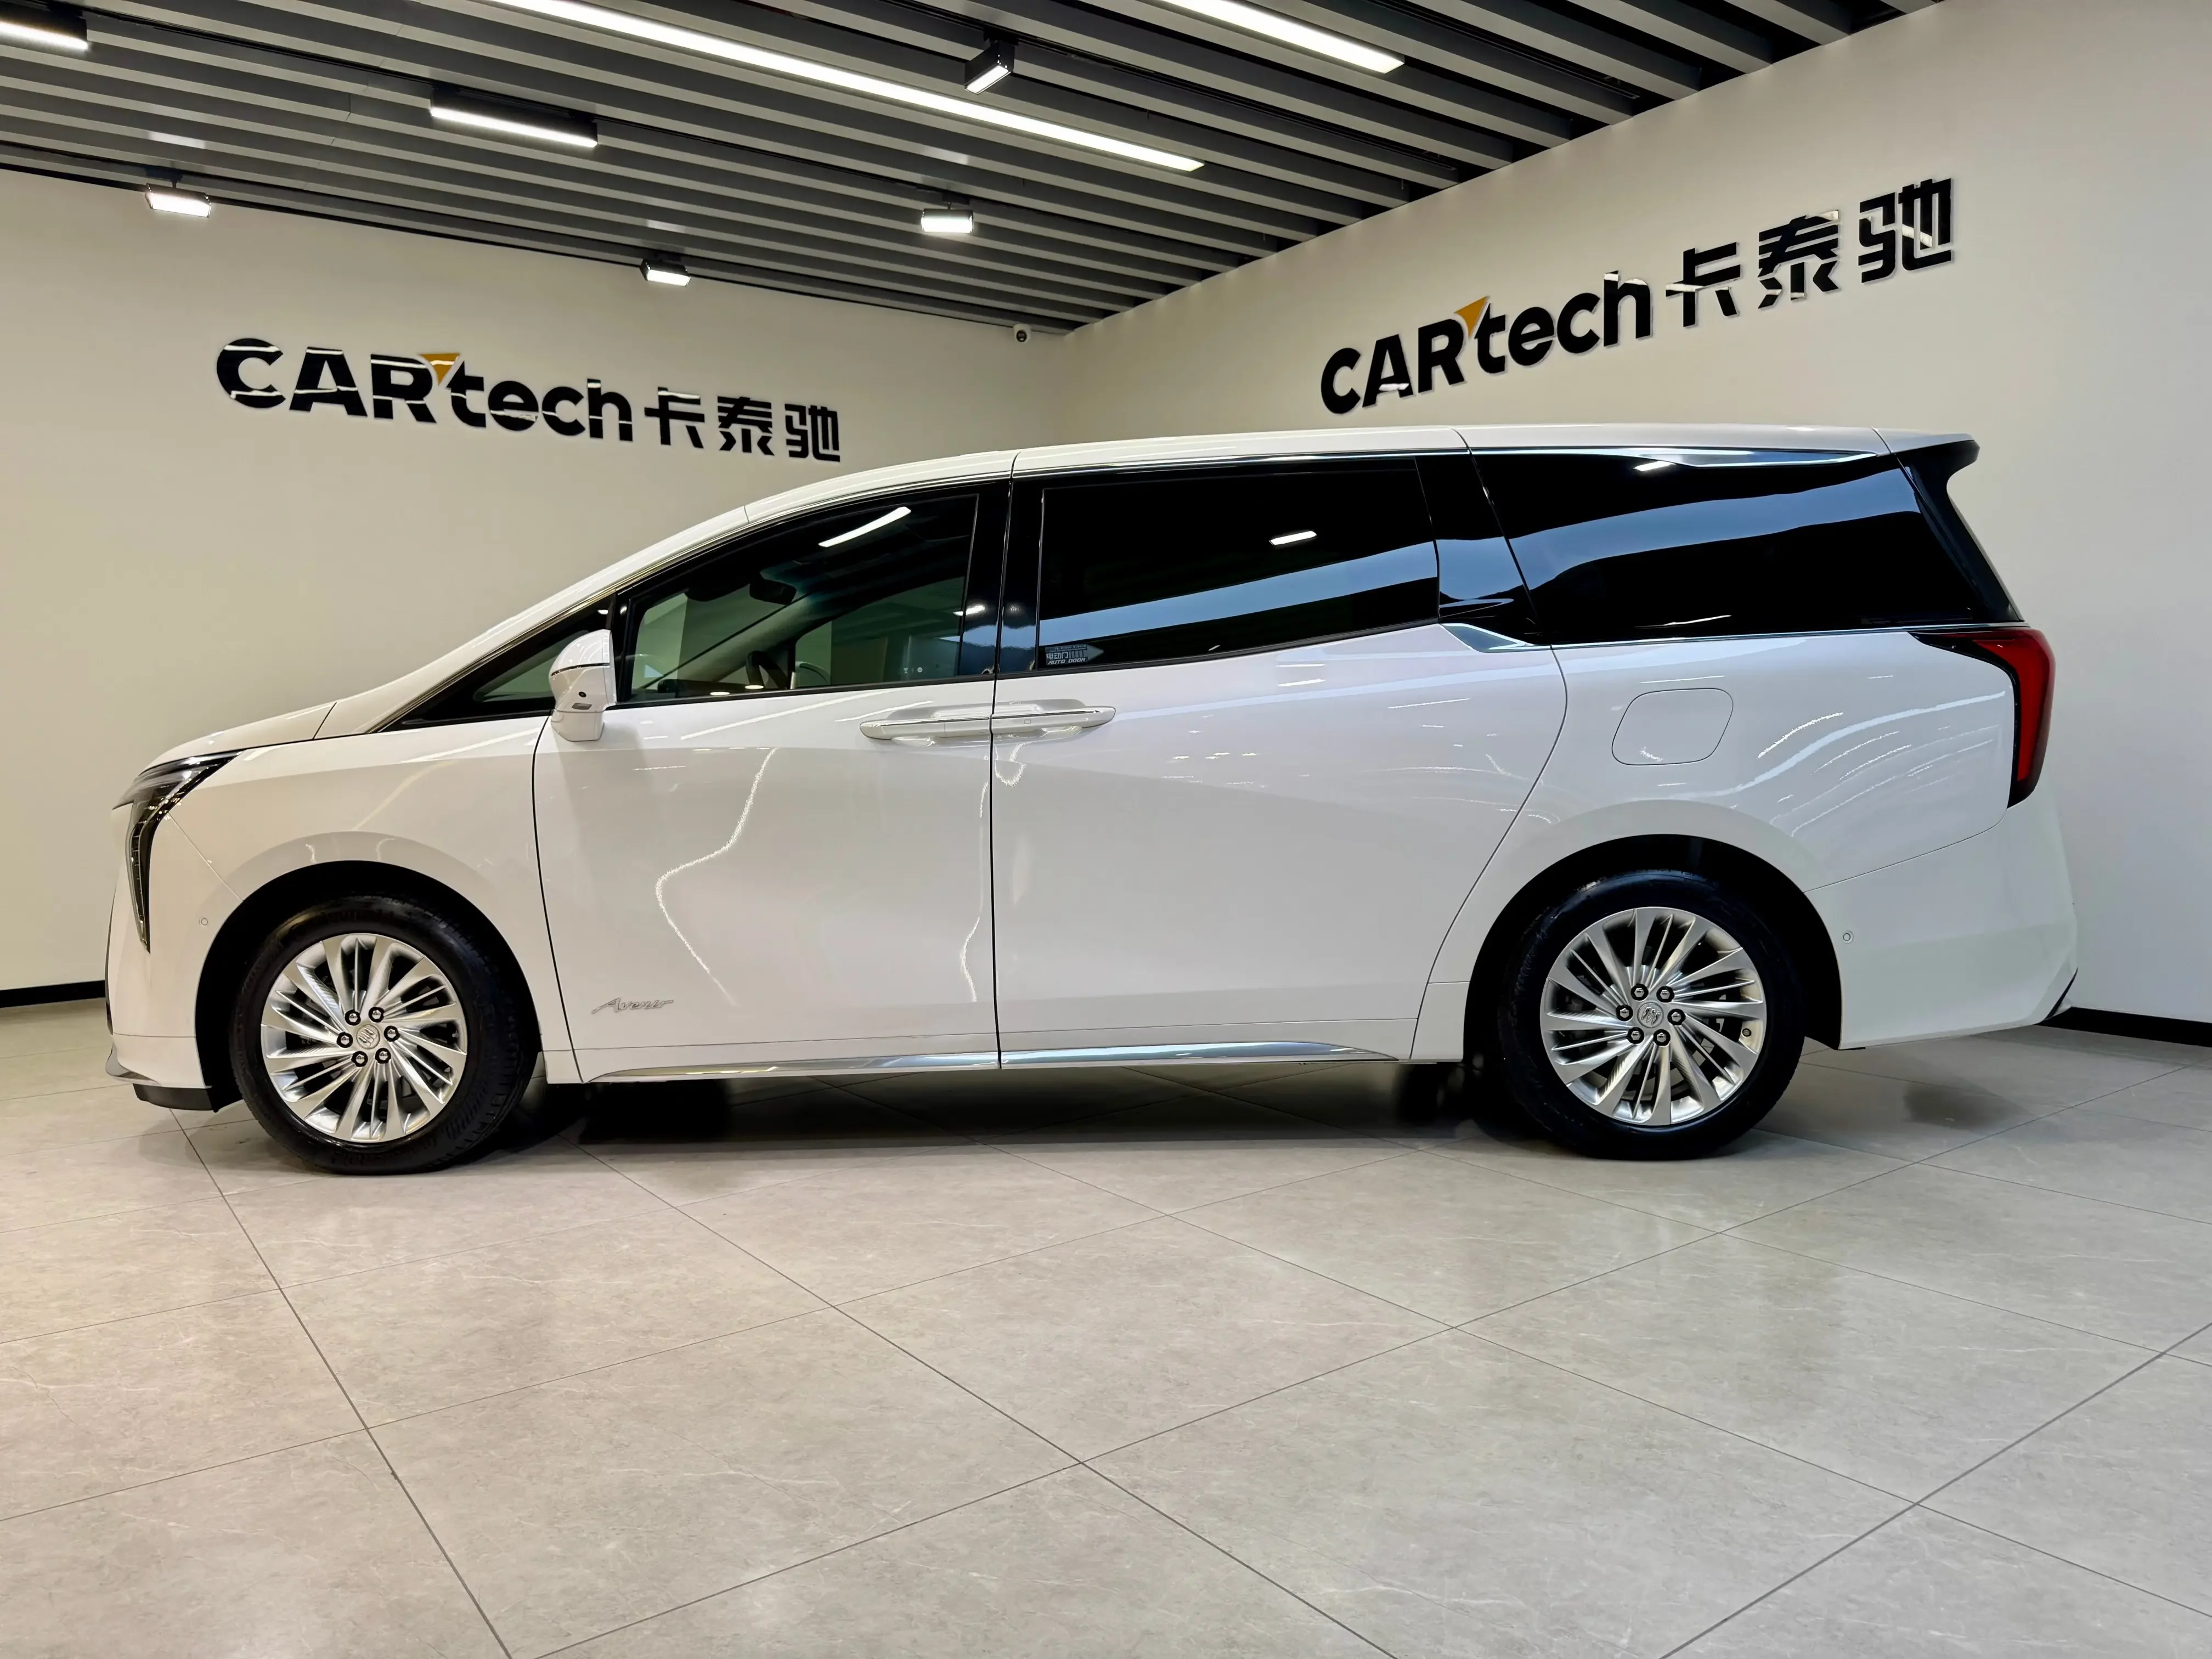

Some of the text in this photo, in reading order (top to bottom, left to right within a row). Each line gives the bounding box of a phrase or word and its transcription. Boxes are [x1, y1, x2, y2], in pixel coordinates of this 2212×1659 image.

[1321, 178, 1954, 414] CARtech 卡泰驰
[216, 338, 841, 462] CARtech 卡泰驰
[1046, 651, 1069, 660] 电动门
[591, 997, 674, 1014] Avenir
